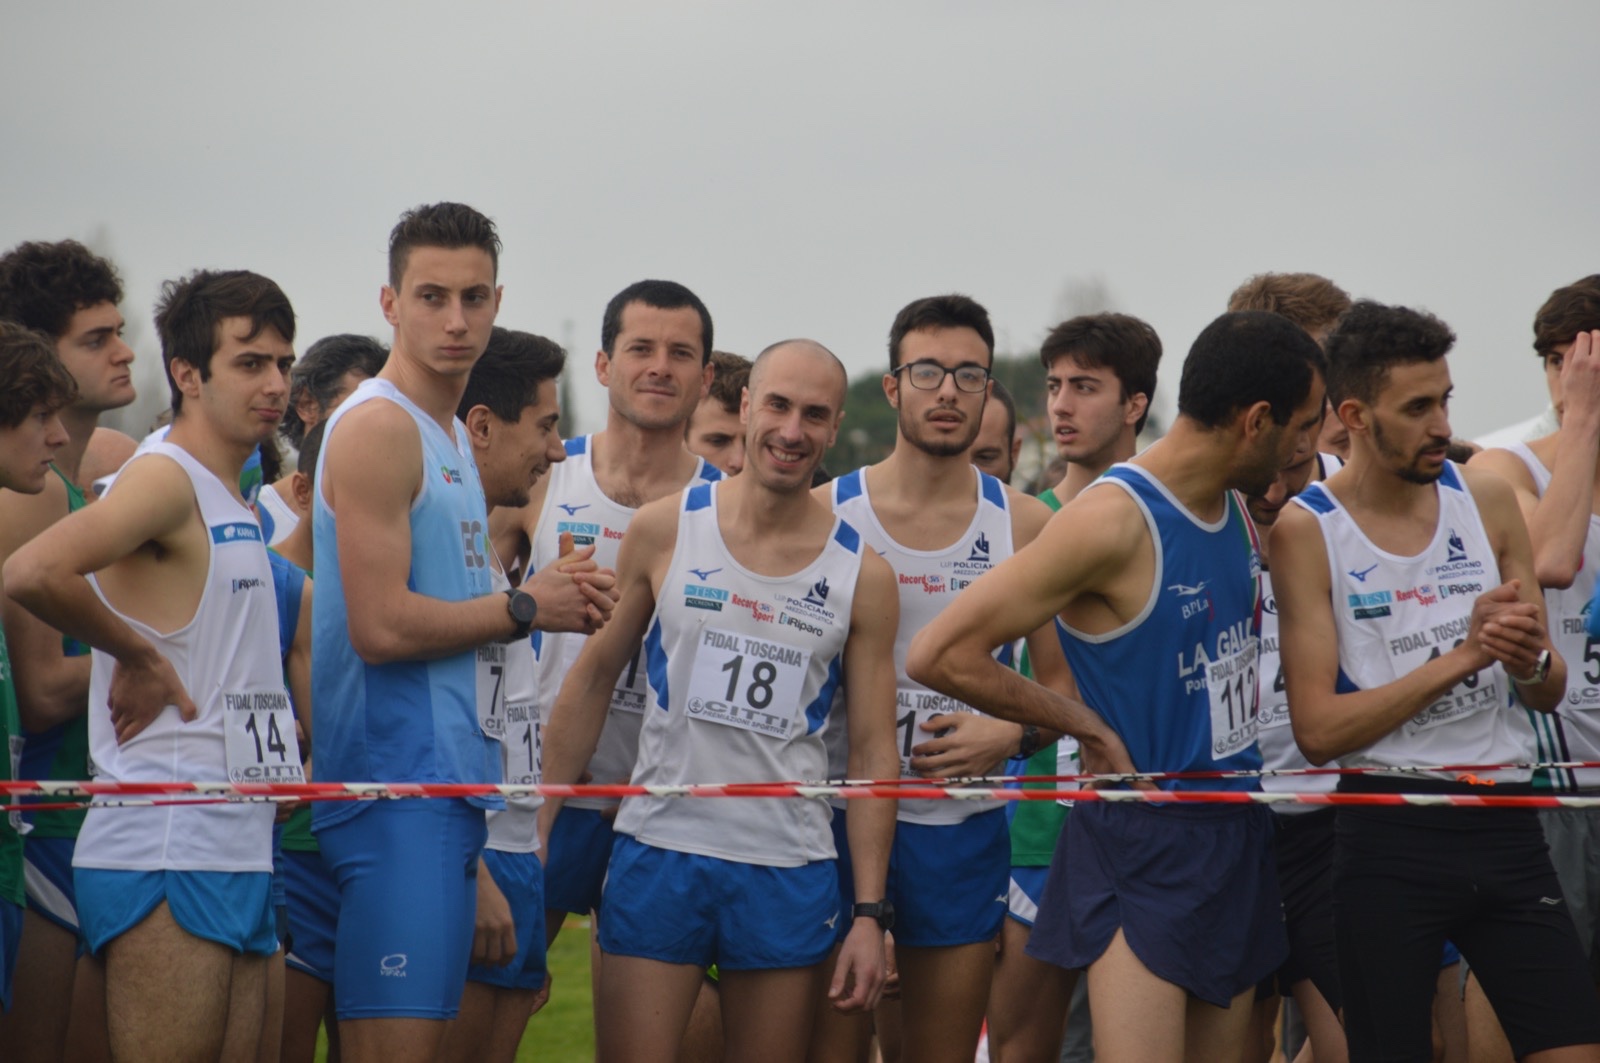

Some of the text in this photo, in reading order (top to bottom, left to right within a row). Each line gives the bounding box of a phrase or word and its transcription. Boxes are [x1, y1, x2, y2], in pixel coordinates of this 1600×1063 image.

[1435, 561, 1482, 574] POLICIANO
[899, 573, 926, 586] Record
[923, 582, 946, 595] Sport
[731, 593, 759, 609] Record
[787, 597, 835, 619] POLICIANO
[752, 608, 775, 624] Sport
[478, 647, 499, 662] FIDAL
[704, 630, 803, 667] FIDAL TOSCANA
[1390, 631, 1431, 656] FIDAL
[1178, 642, 1211, 678] LA
[1209, 660, 1234, 682] FIDAL
[722, 655, 777, 710] 18
[225, 693, 288, 711] FIDAL TOSCANA
[1221, 665, 1257, 730] 112
[1428, 683, 1496, 715] CITTI
[507, 706, 529, 723] FIDAL
[704, 701, 789, 729] CITTI
[245, 712, 287, 764] 14
[243, 766, 303, 779] CITTI
